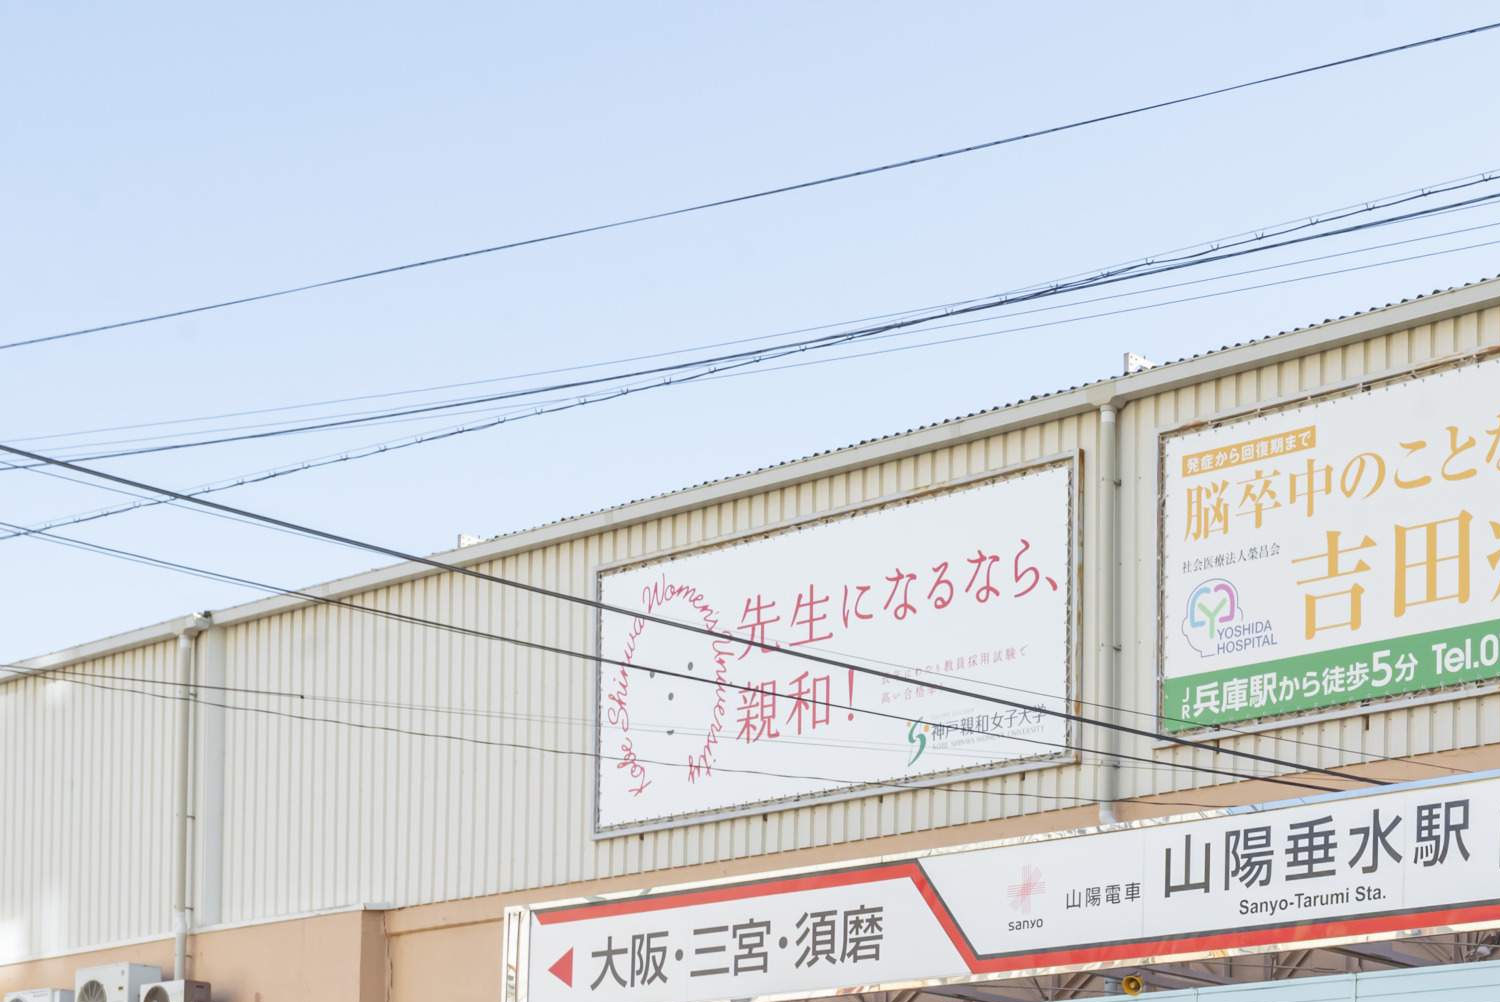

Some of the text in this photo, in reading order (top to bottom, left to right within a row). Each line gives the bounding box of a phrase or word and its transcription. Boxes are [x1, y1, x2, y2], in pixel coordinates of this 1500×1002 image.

[1187, 430, 1311, 474] 発症から回復期まで
[1182, 542, 1281, 574] 社会医療法人榮昌会
[737, 538, 1058, 661] 先生になるなら、
[1217, 620, 1272, 641] YOSHIDA
[1217, 633, 1278, 655] HOSPITAL
[736, 668, 856, 743] 親和!
[931, 704, 1047, 742] 神戸親和女子大学
[951, 738, 975, 748] SHINWA
[1008, 726, 1045, 739] UNIVERSITY
[1164, 800, 1470, 898] 山陽垂水駅
[1066, 882, 1141, 909] 山陽電車
[1239, 886, 1387, 917] Sanyo-Tarumi Sta.
[1008, 918, 1044, 932] sanyo
[590, 905, 884, 991] 大阪・三宮・須磨
